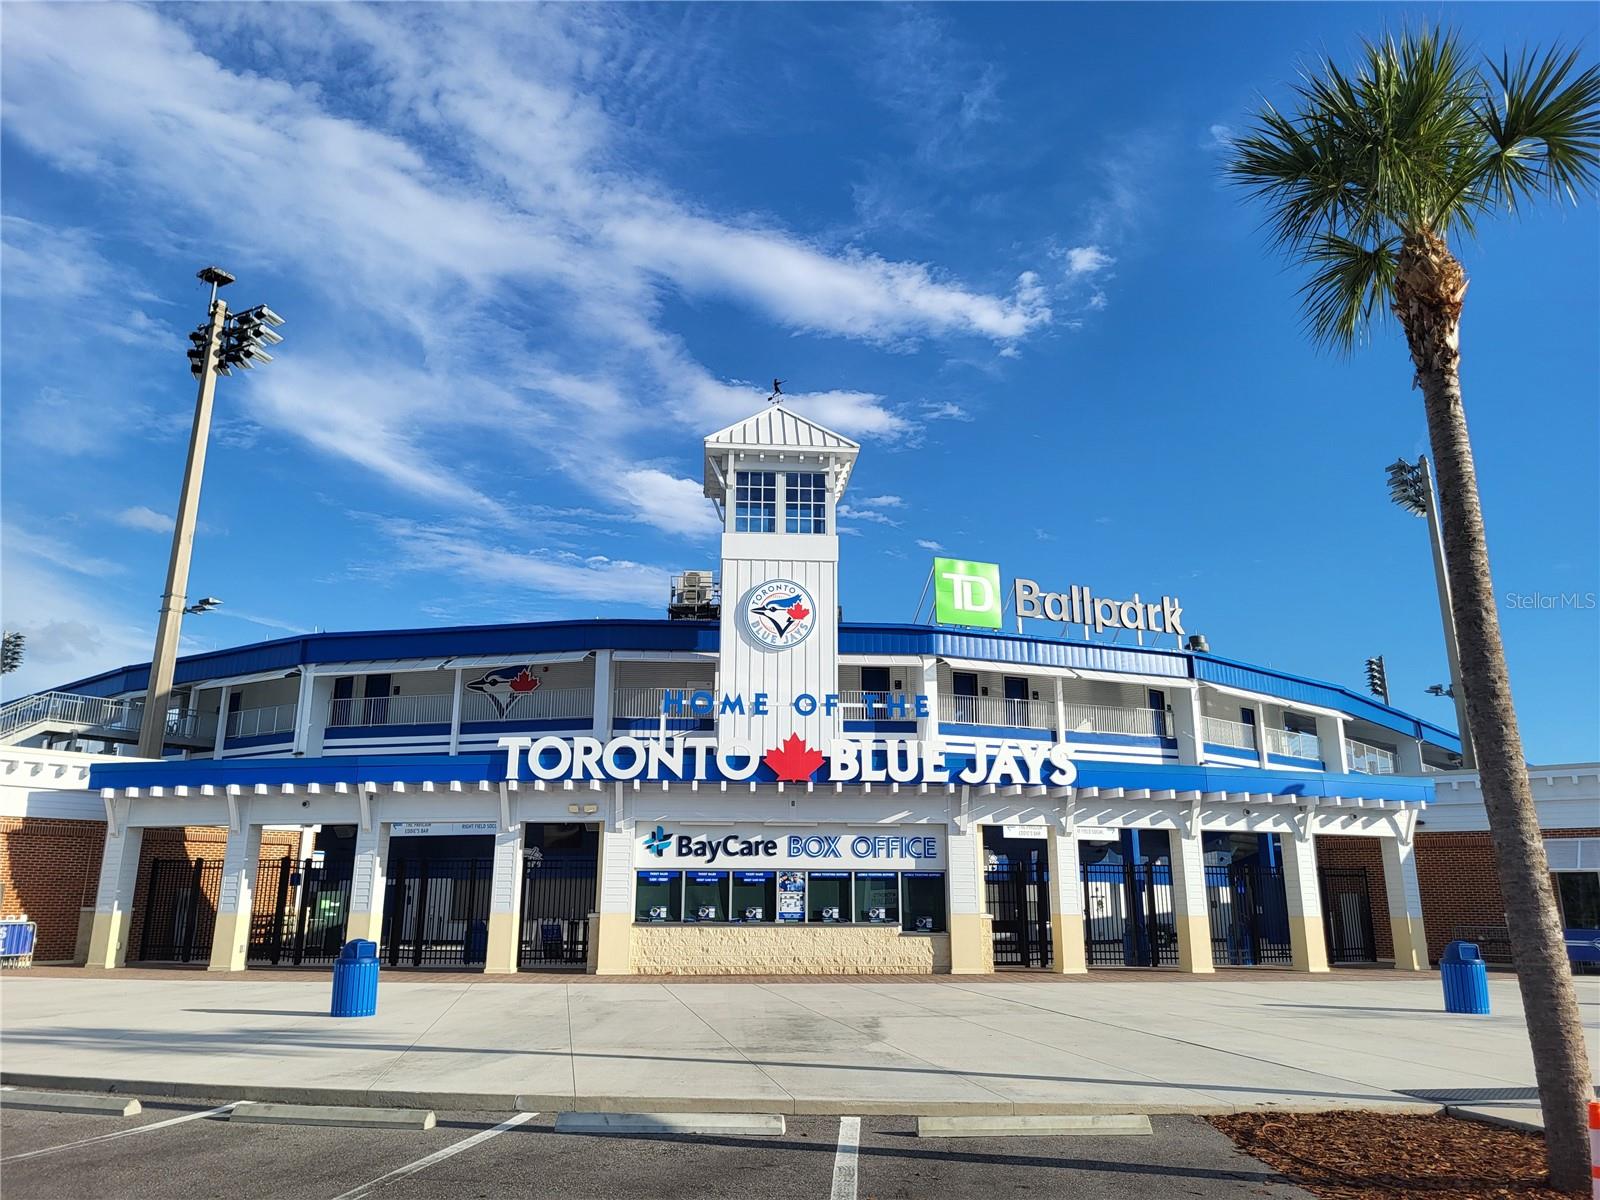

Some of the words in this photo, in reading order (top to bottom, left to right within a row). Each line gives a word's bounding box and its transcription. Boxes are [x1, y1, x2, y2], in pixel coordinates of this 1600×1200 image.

[751, 584, 797, 607] TORONTO
[942, 572, 994, 612] TD
[1014, 578, 1185, 636] Ballpark
[751, 620, 777, 644] BLUE
[783, 622, 809, 645] JAYS
[664, 689, 769, 716] HOME
[794, 693, 839, 717] OF
[862, 694, 929, 718] THE
[497, 735, 760, 781] TORONTO
[828, 739, 950, 783] BLUE
[959, 740, 1078, 786] JAYS
[676, 834, 777, 864] BayCare
[787, 835, 842, 859] BOX
[851, 836, 937, 860] OFFICE
